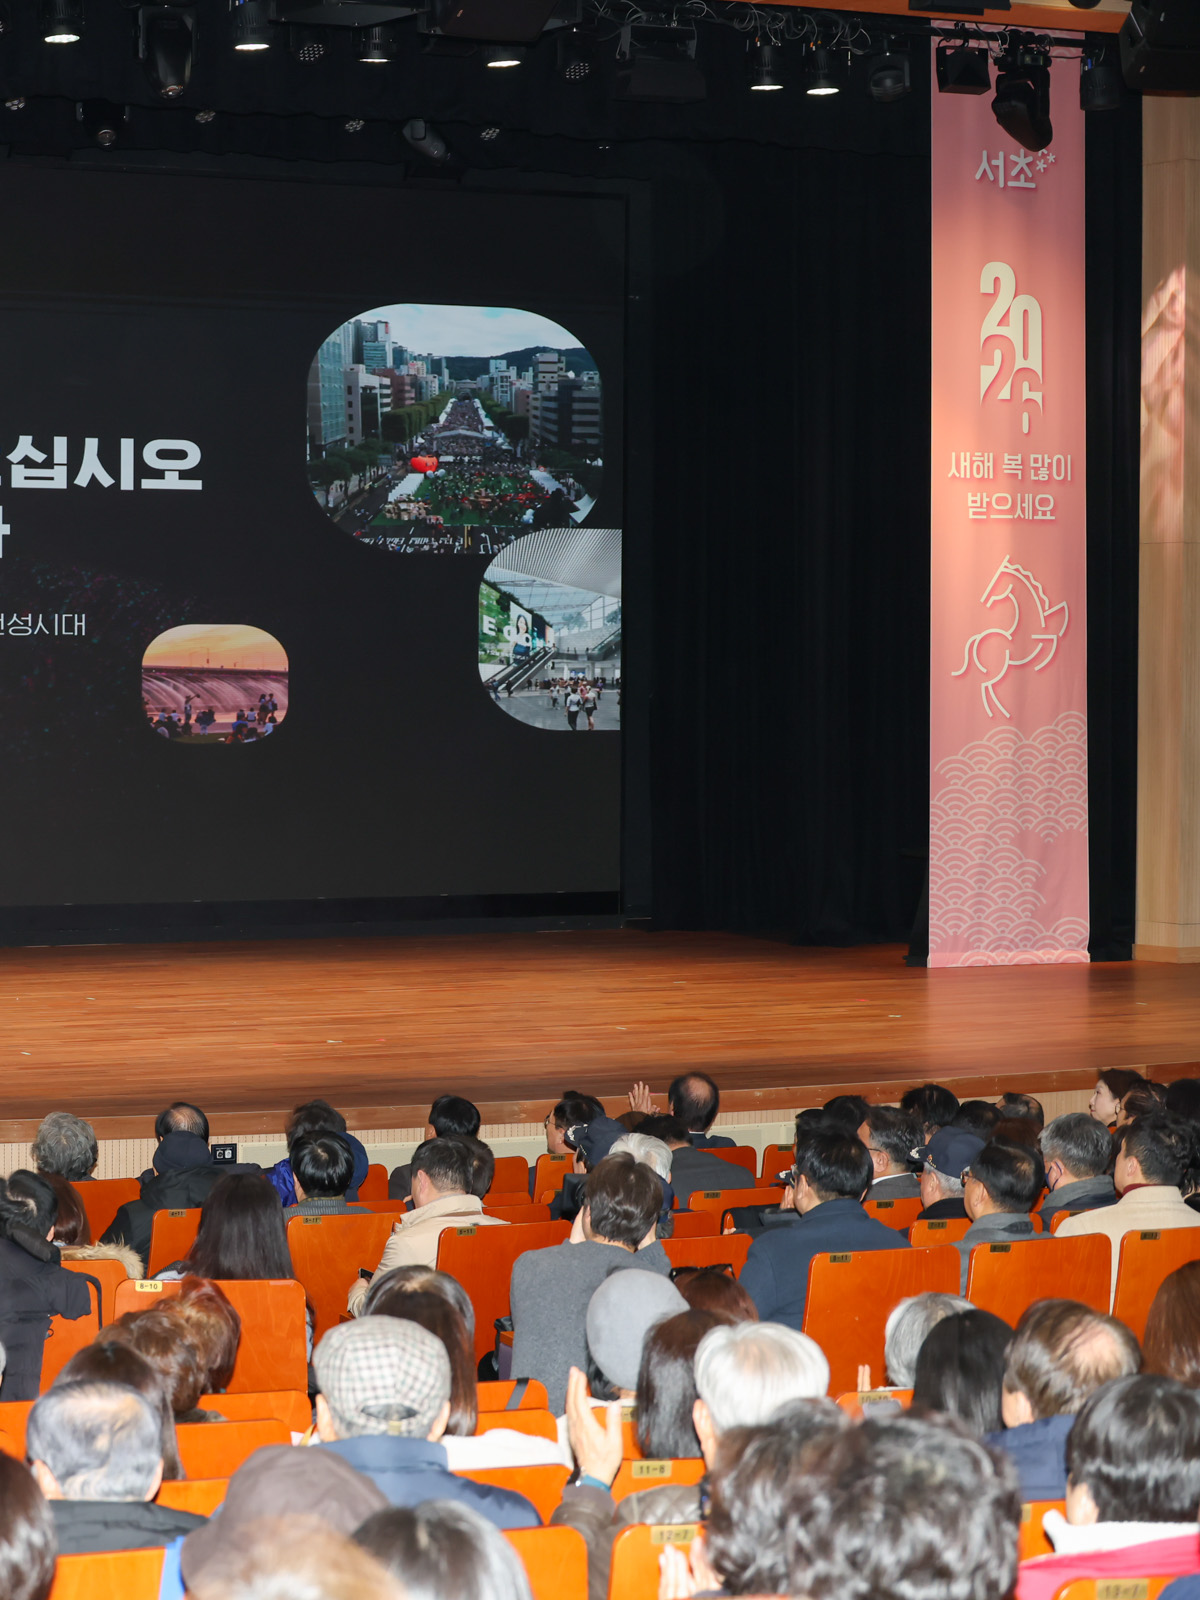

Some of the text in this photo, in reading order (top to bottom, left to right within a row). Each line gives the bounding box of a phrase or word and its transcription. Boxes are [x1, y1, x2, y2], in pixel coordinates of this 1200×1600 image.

[975, 148, 1036, 189] 서초
[947, 451, 1072, 482] 새해 복 많이
[966, 492, 1056, 521] 받으세요
